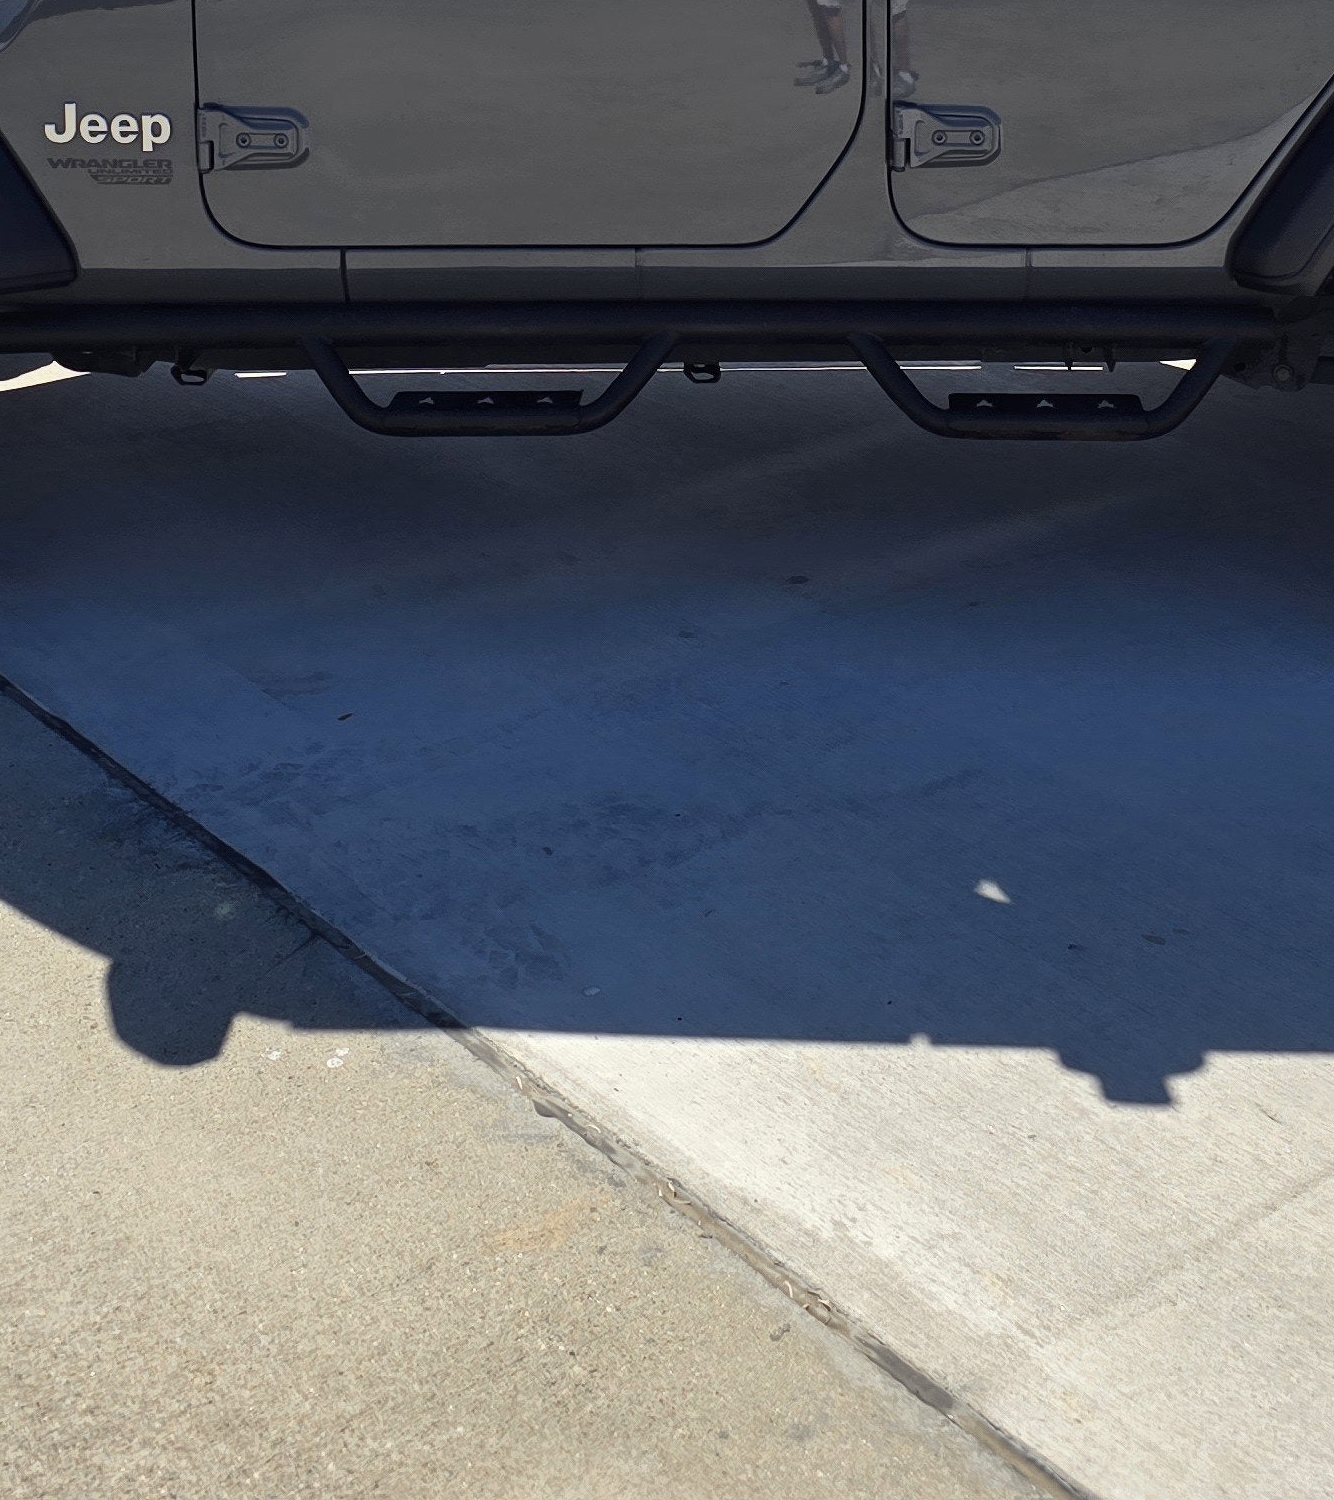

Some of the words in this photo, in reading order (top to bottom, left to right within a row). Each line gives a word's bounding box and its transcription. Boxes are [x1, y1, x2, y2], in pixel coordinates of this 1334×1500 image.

[43, 102, 172, 152] Jeep
[47, 157, 173, 169] WRANGLER
[87, 167, 174, 175] UNLIMITED
[91, 174, 174, 185] SPORT
